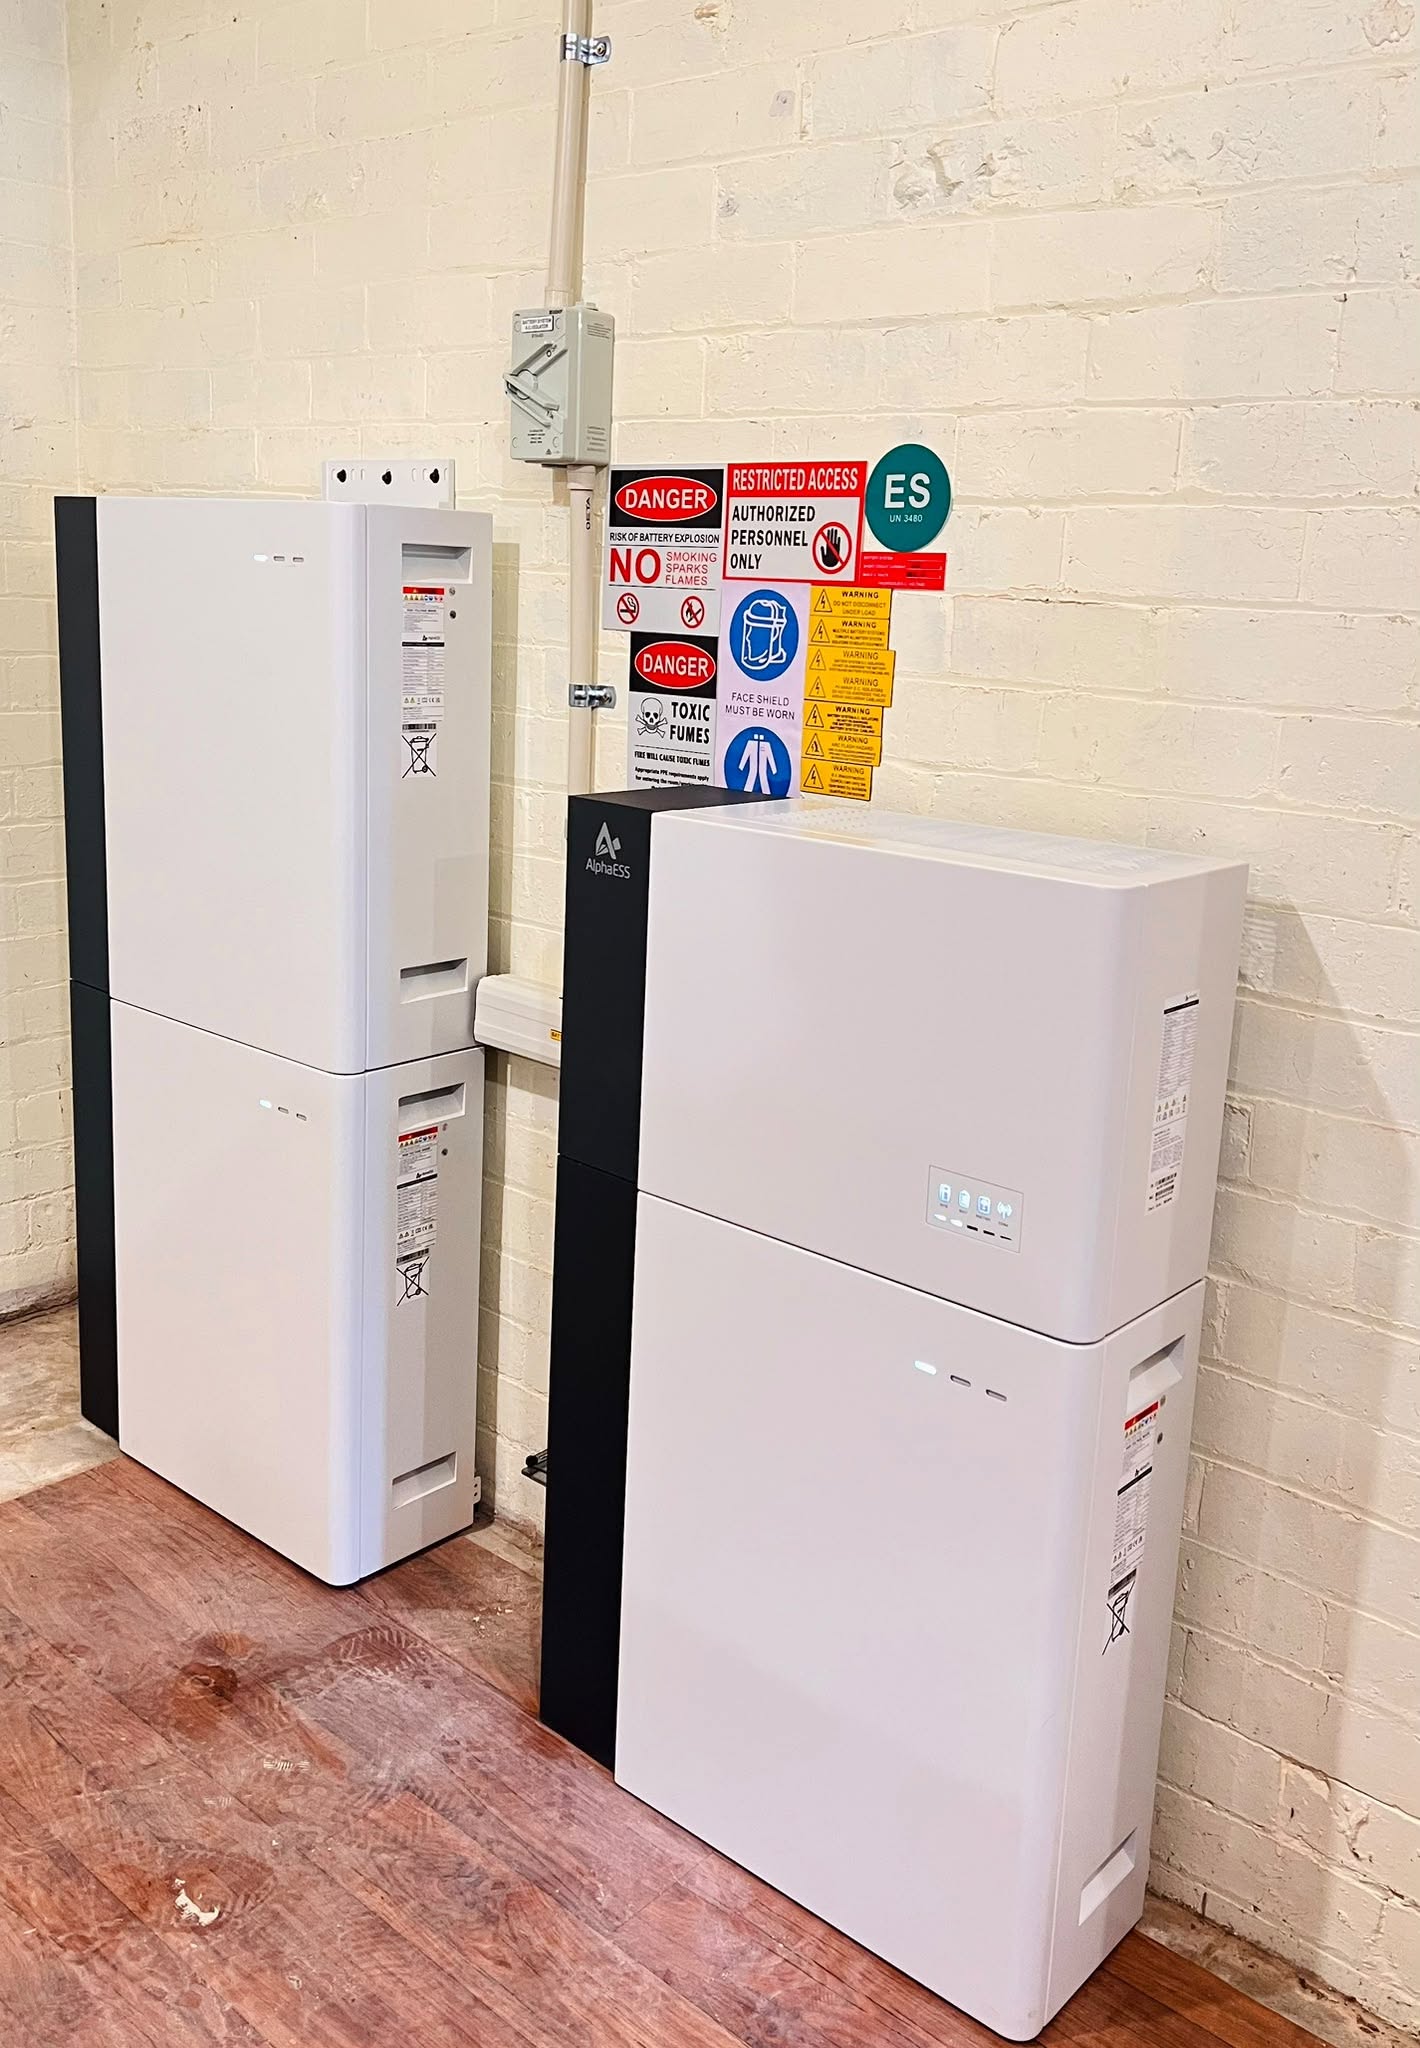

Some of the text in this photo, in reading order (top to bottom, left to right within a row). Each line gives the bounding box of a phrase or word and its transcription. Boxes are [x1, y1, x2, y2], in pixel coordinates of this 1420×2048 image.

[733, 467, 858, 490] RESTRICTED ACCESS
[884, 472, 930, 508] ES
[625, 488, 708, 510] DANGER
[732, 506, 816, 522] AUTHORIZED
[904, 514, 923, 522] 3480
[610, 532, 719, 543] RISK OF BATTERY EXPLOSION
[731, 530, 808, 546] PERSONNEL
[666, 552, 717, 562] SMOKING
[730, 554, 762, 569] ONLY
[610, 548, 661, 584] NO
[666, 563, 708, 574] SPARKS
[665, 575, 708, 585] FLAMES
[843, 650, 878, 660] WARNING
[642, 654, 709, 678] DANGER
[843, 677, 878, 687] WARNING
[732, 692, 789, 706] FACE SHIELD
[671, 701, 710, 721] TOXIC
[725, 704, 795, 720] MUST BE WORN
[835, 706, 870, 715] WARNING
[670, 725, 710, 744] FUMES
[838, 735, 868, 744] WARNING
[635, 751, 645, 759] FIRE
[659, 754, 675, 762] CAUSE
[676, 756, 692, 764] TOXIC
[692, 758, 710, 766] FUMES
[833, 765, 864, 774] WARNING
[585, 857, 630, 879] AlphaESS
